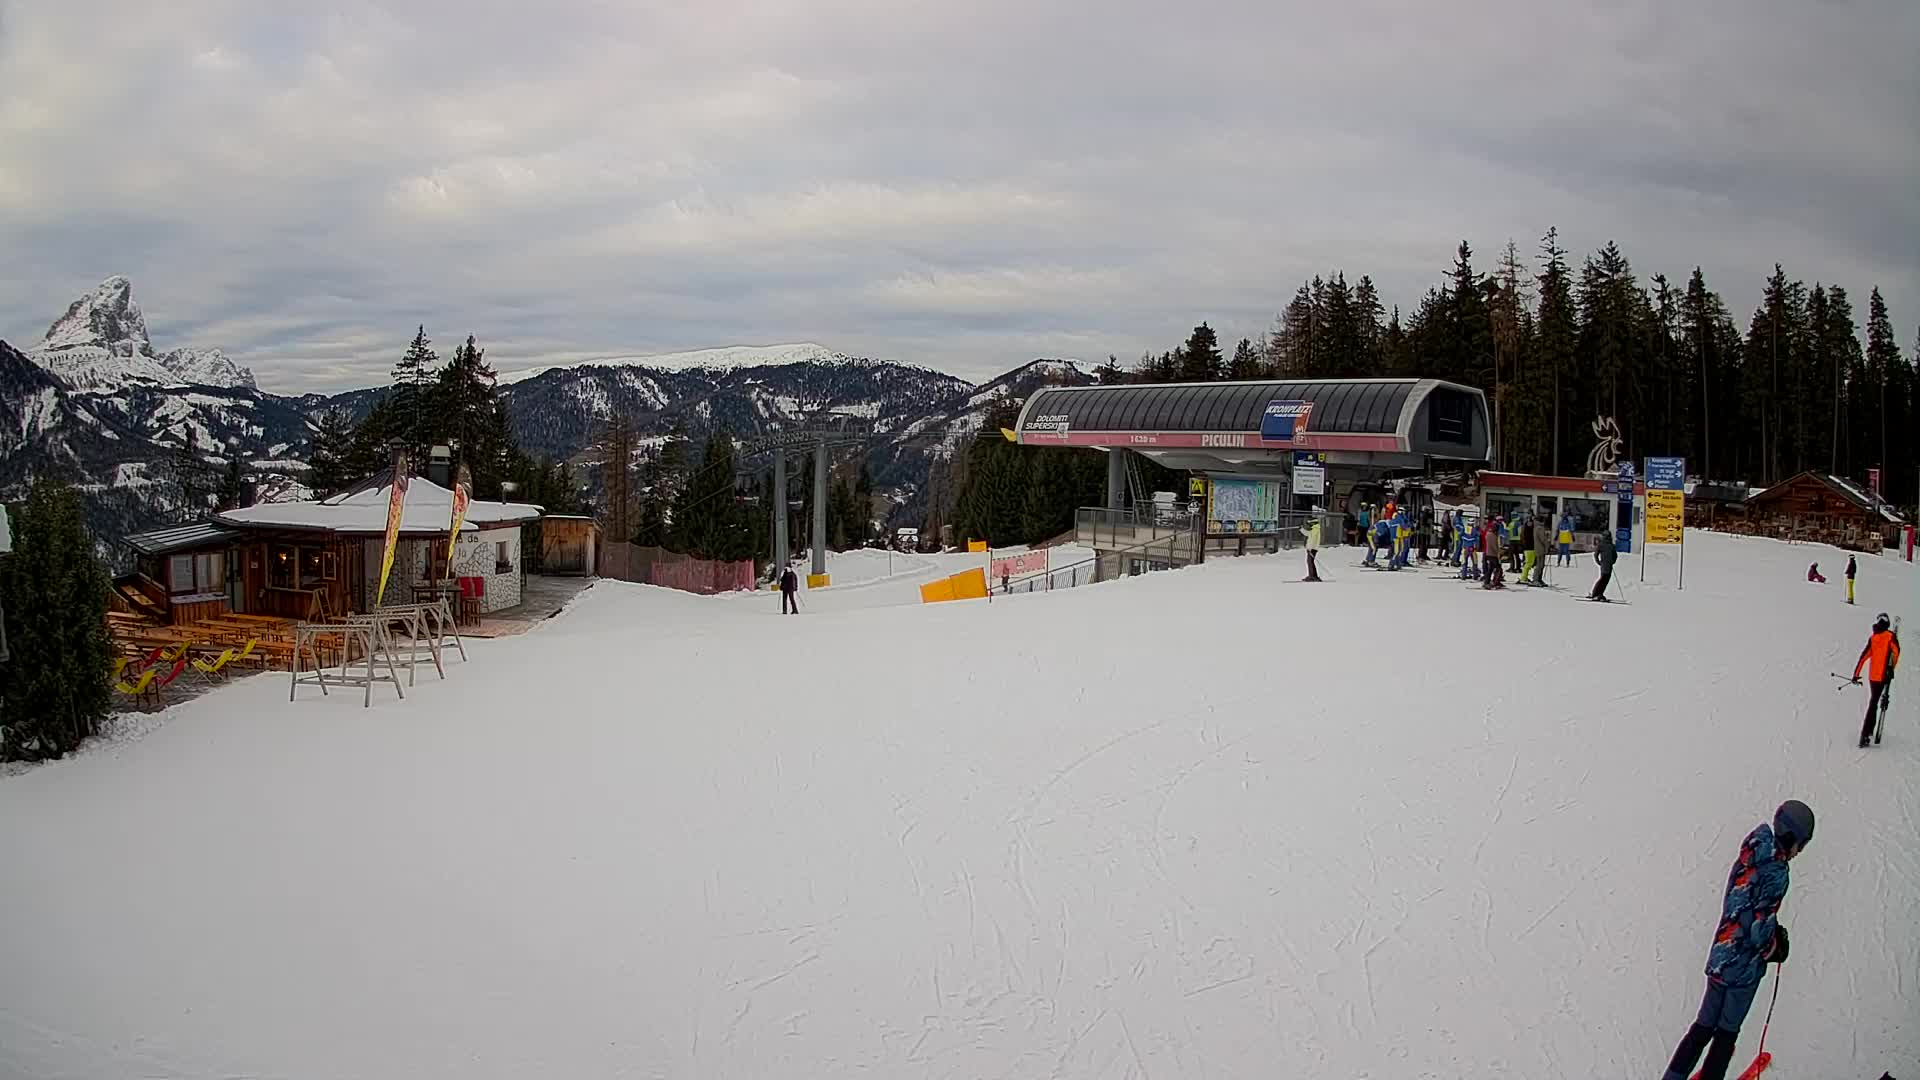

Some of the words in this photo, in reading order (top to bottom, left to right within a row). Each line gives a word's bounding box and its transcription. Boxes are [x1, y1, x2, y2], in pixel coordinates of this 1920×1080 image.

[1265, 404, 1311, 414] KRONPLATZ
[1036, 414, 1069, 422] DOLOMITI
[1025, 422, 1058, 430] SUPERSKI
[1201, 434, 1245, 447] PICULIN
